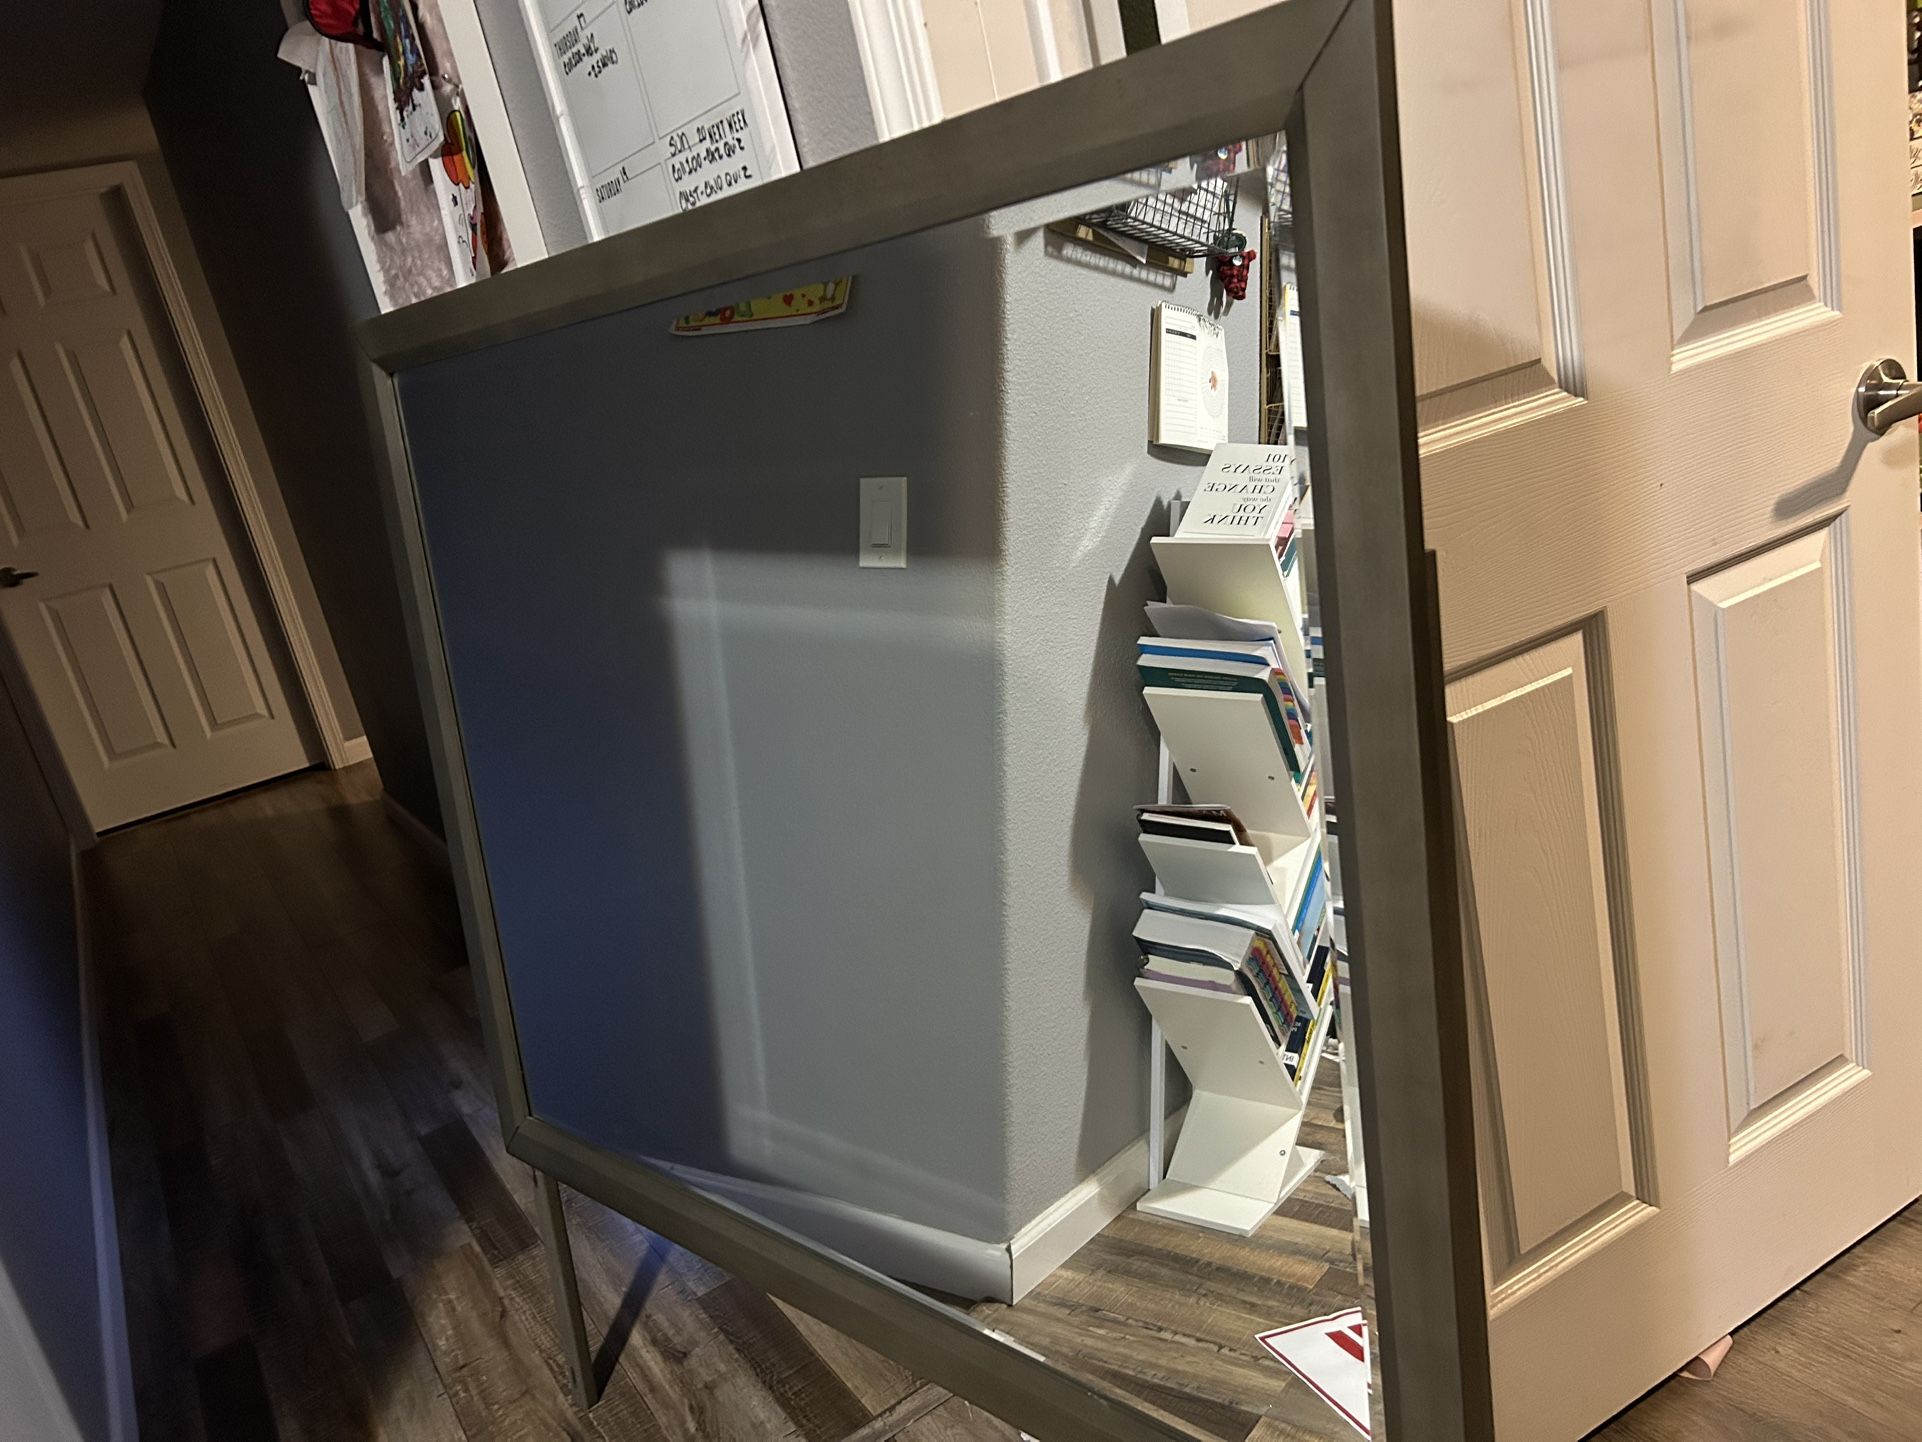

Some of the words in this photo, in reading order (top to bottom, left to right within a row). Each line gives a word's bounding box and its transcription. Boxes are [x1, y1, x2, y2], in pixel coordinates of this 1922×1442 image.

[707, 119, 727, 145] NEXT
[726, 108, 748, 134] WEEK
[595, 177, 622, 203] SATURDAY
